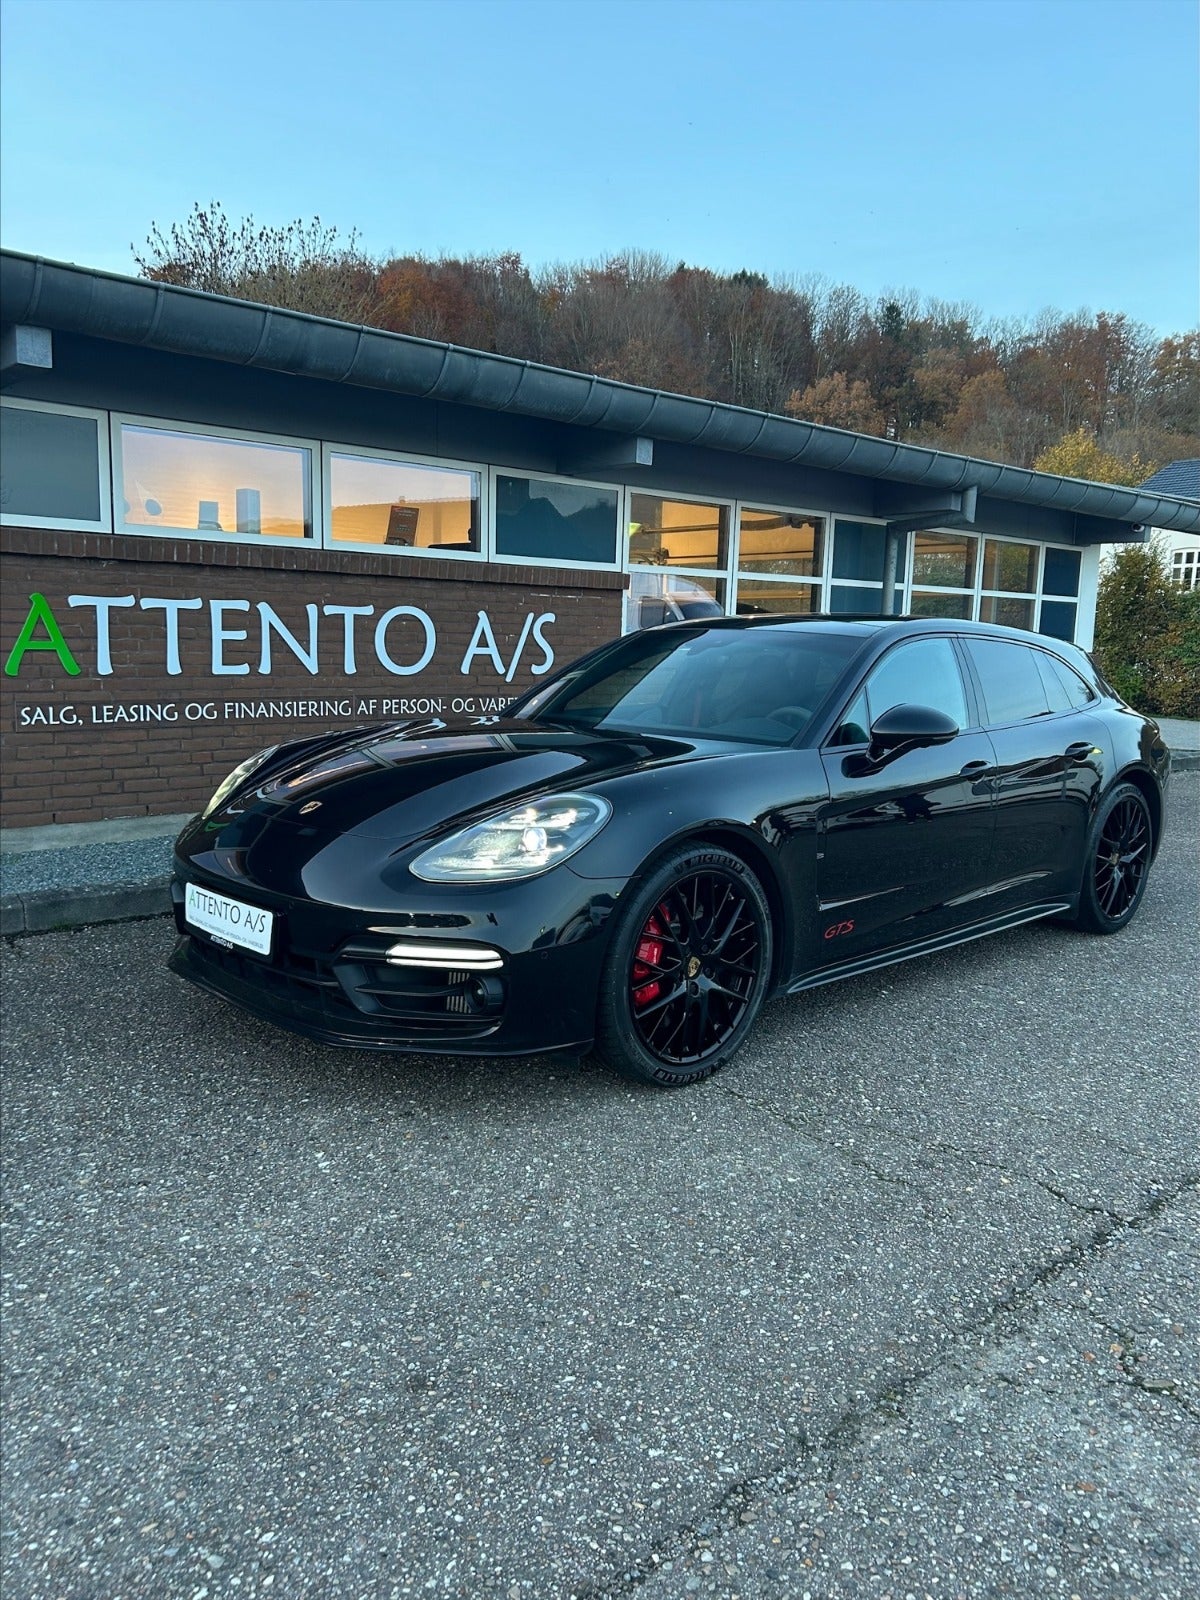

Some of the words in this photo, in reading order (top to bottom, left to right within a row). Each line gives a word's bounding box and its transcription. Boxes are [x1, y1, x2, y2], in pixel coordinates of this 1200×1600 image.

[4, 592, 437, 676] ATTENTO
[460, 610, 557, 683] A/S
[20, 705, 84, 726] SALG,
[91, 703, 179, 724] LEASING
[184, 702, 218, 720] OG
[224, 700, 352, 719] FINANSIERING
[356, 699, 378, 715] AF
[382, 698, 448, 715] PERSON-
[451, 697, 475, 713] OG
[690, 854, 743, 871] MICHELIN
[189, 889, 240, 924] ATTENTO
[244, 911, 265, 933] A/S
[824, 920, 855, 939] GTS
